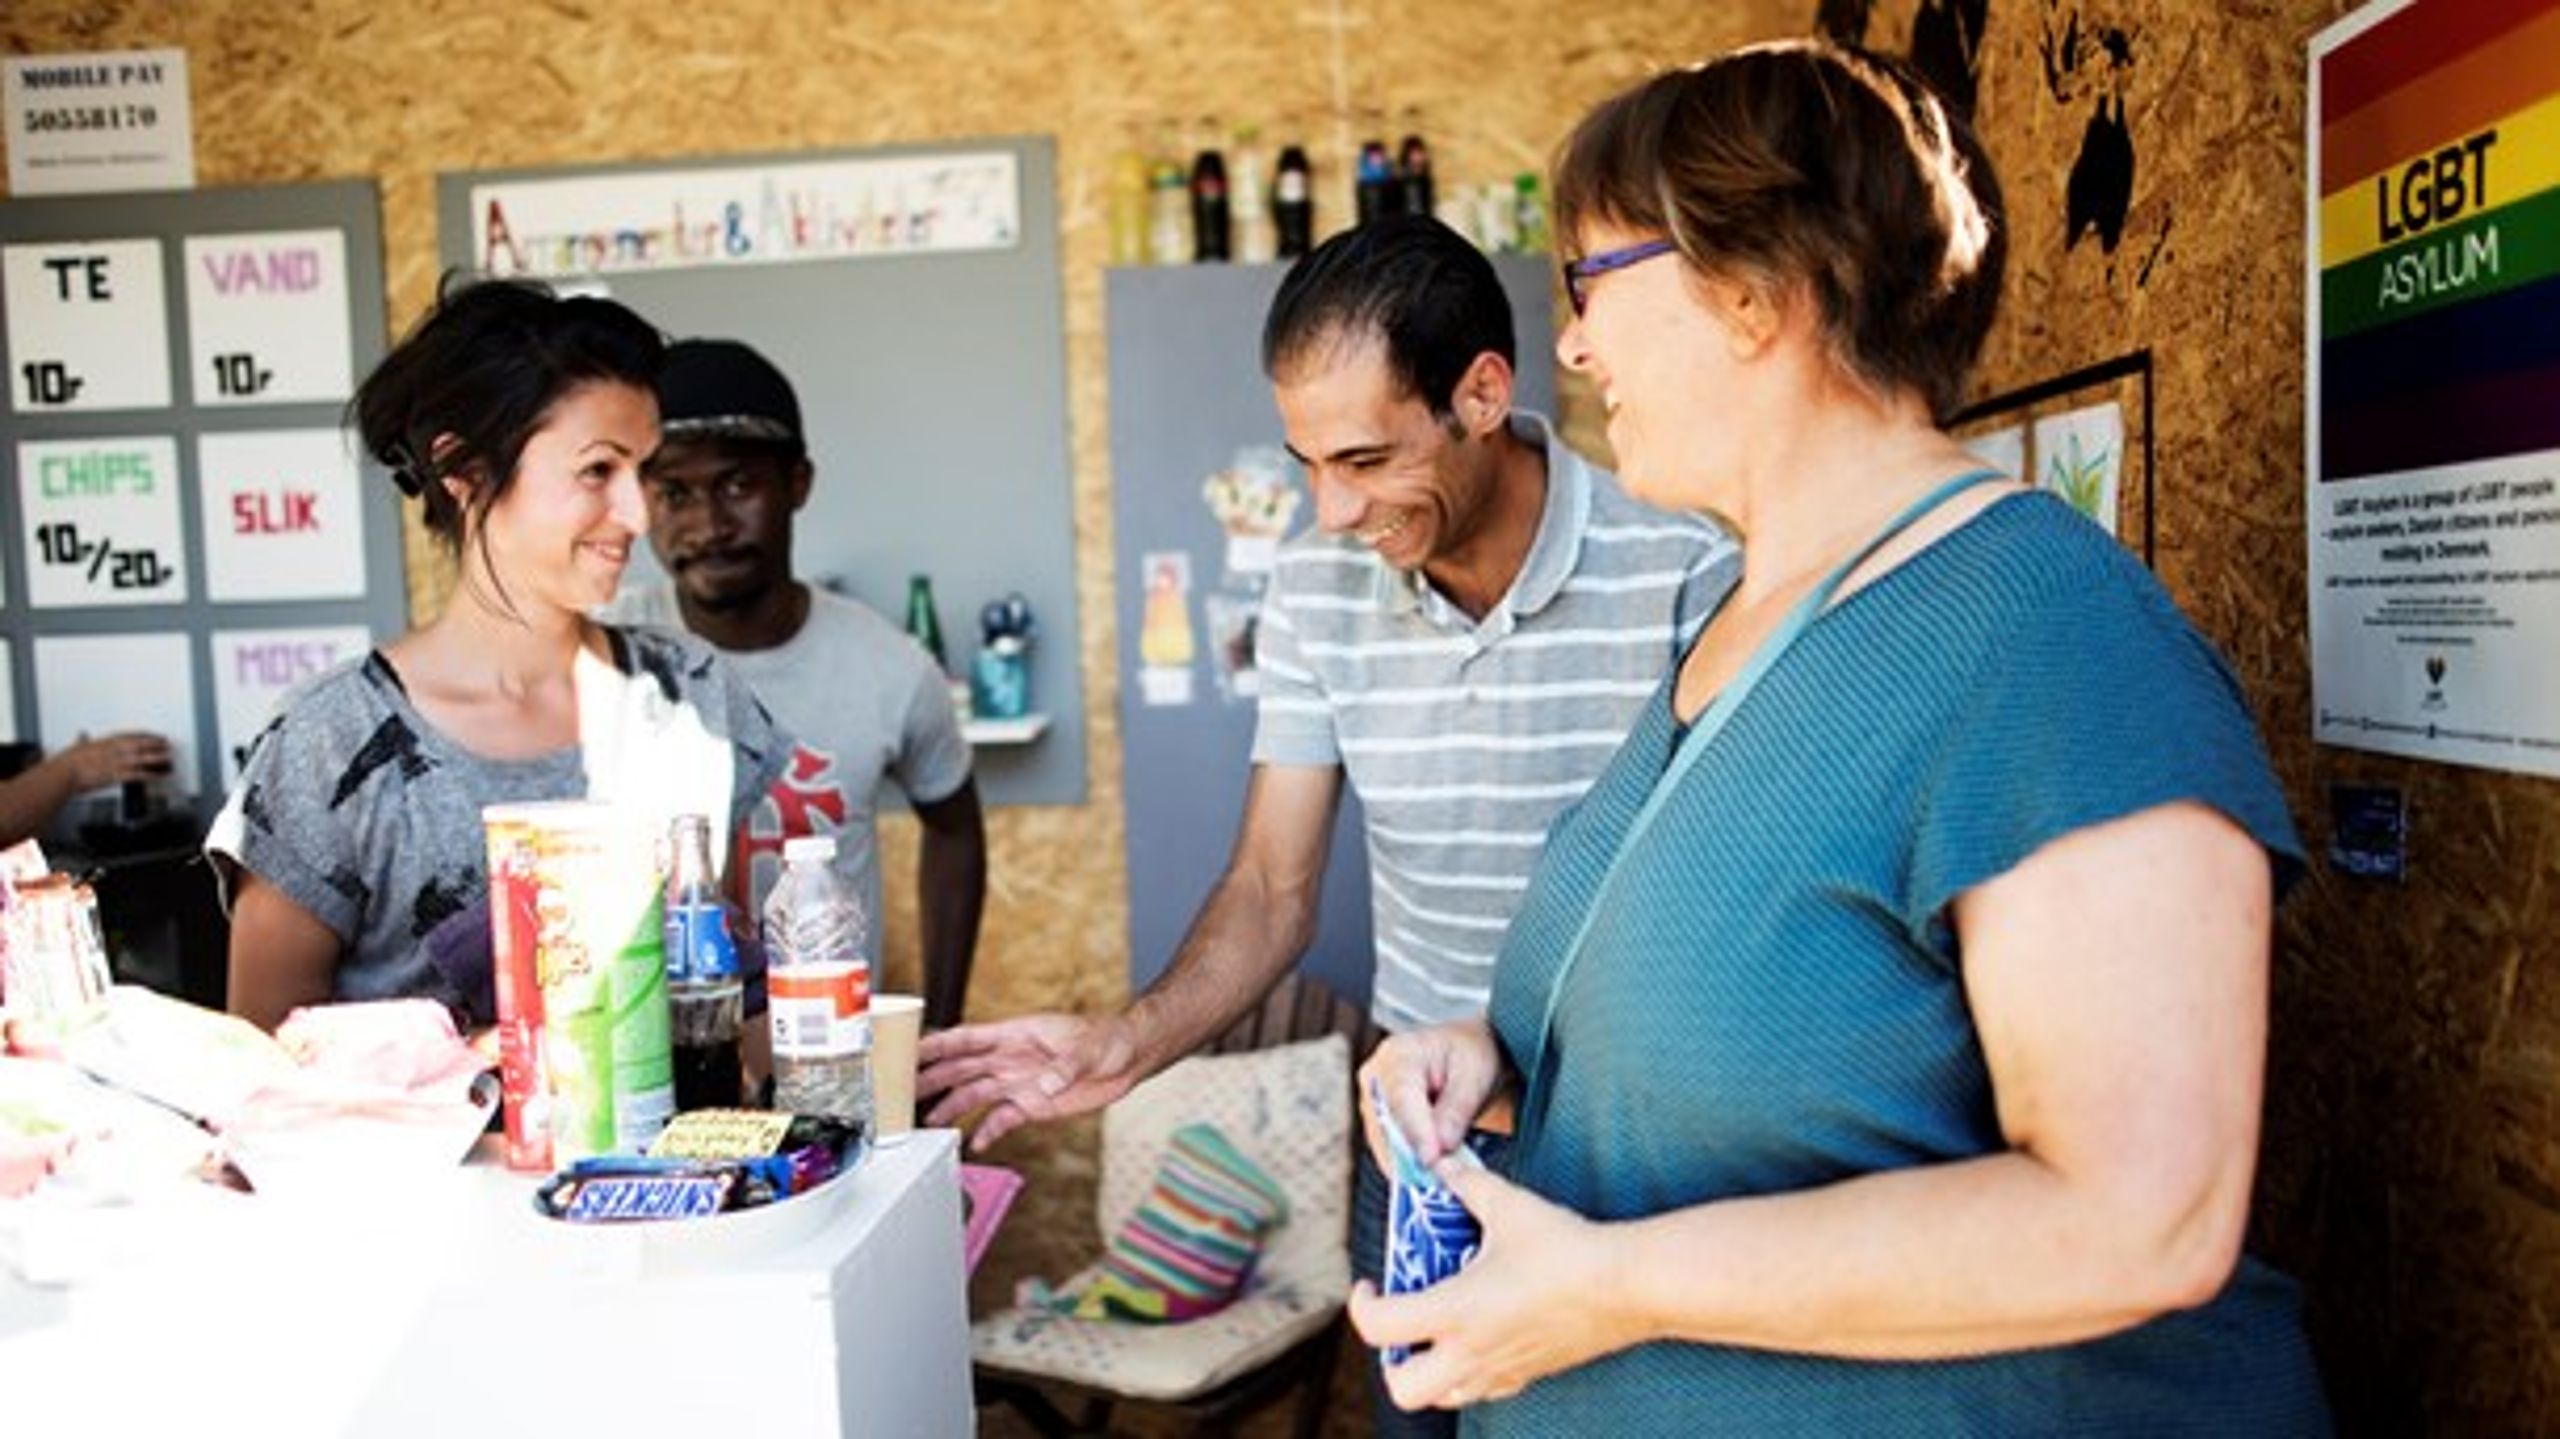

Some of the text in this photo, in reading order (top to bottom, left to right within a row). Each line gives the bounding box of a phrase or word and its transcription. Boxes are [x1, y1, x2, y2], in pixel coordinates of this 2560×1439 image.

[21, 62, 164, 90] MOBILE PAY
[2378, 129, 2498, 243] LGBT
[44, 256, 112, 301] TE
[204, 250, 320, 294] VAND
[2378, 224, 2499, 310] ASYLUM
[40, 452, 154, 497] CHIPS
[232, 491, 320, 534] SLIK
